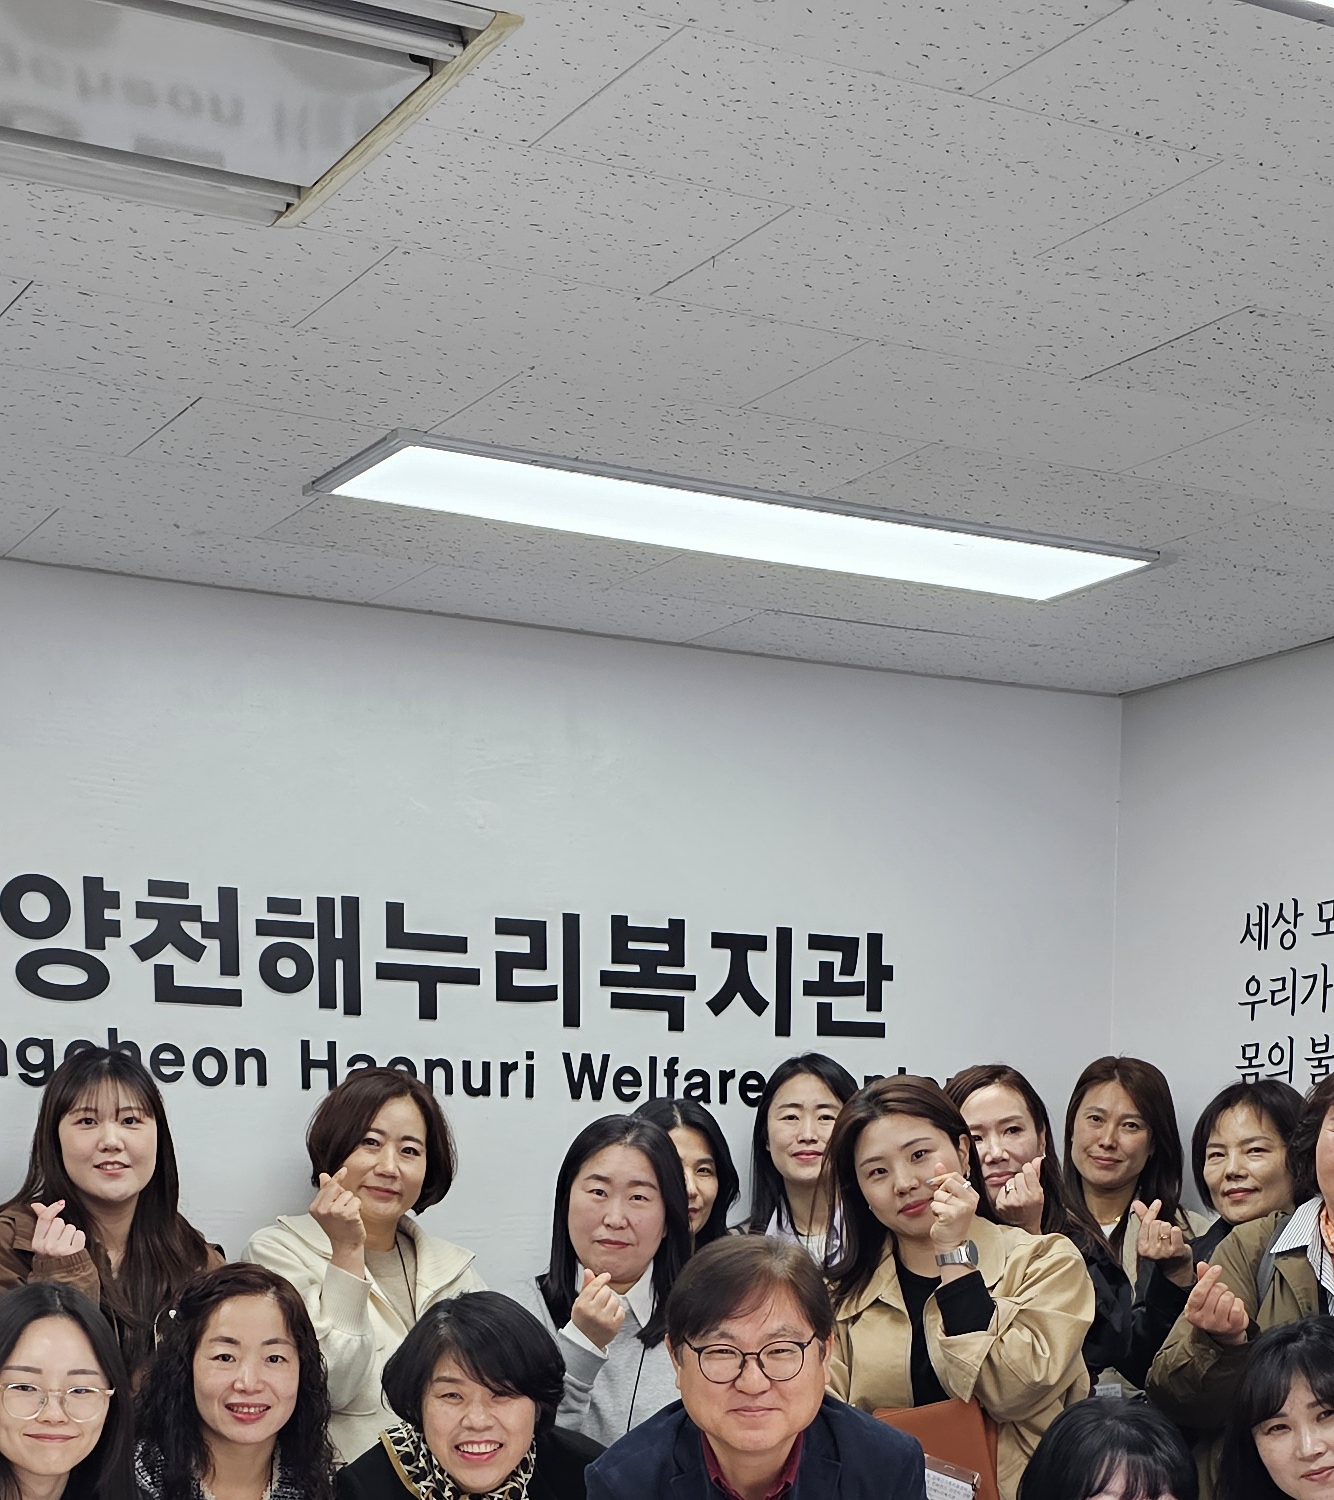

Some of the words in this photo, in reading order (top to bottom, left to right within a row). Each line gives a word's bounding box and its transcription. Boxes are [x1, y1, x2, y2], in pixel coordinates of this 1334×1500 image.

[1240, 897, 1304, 951] 세상
[1238, 963, 1333, 1022] 우리가
[562, 1052, 767, 1107] Welfare
